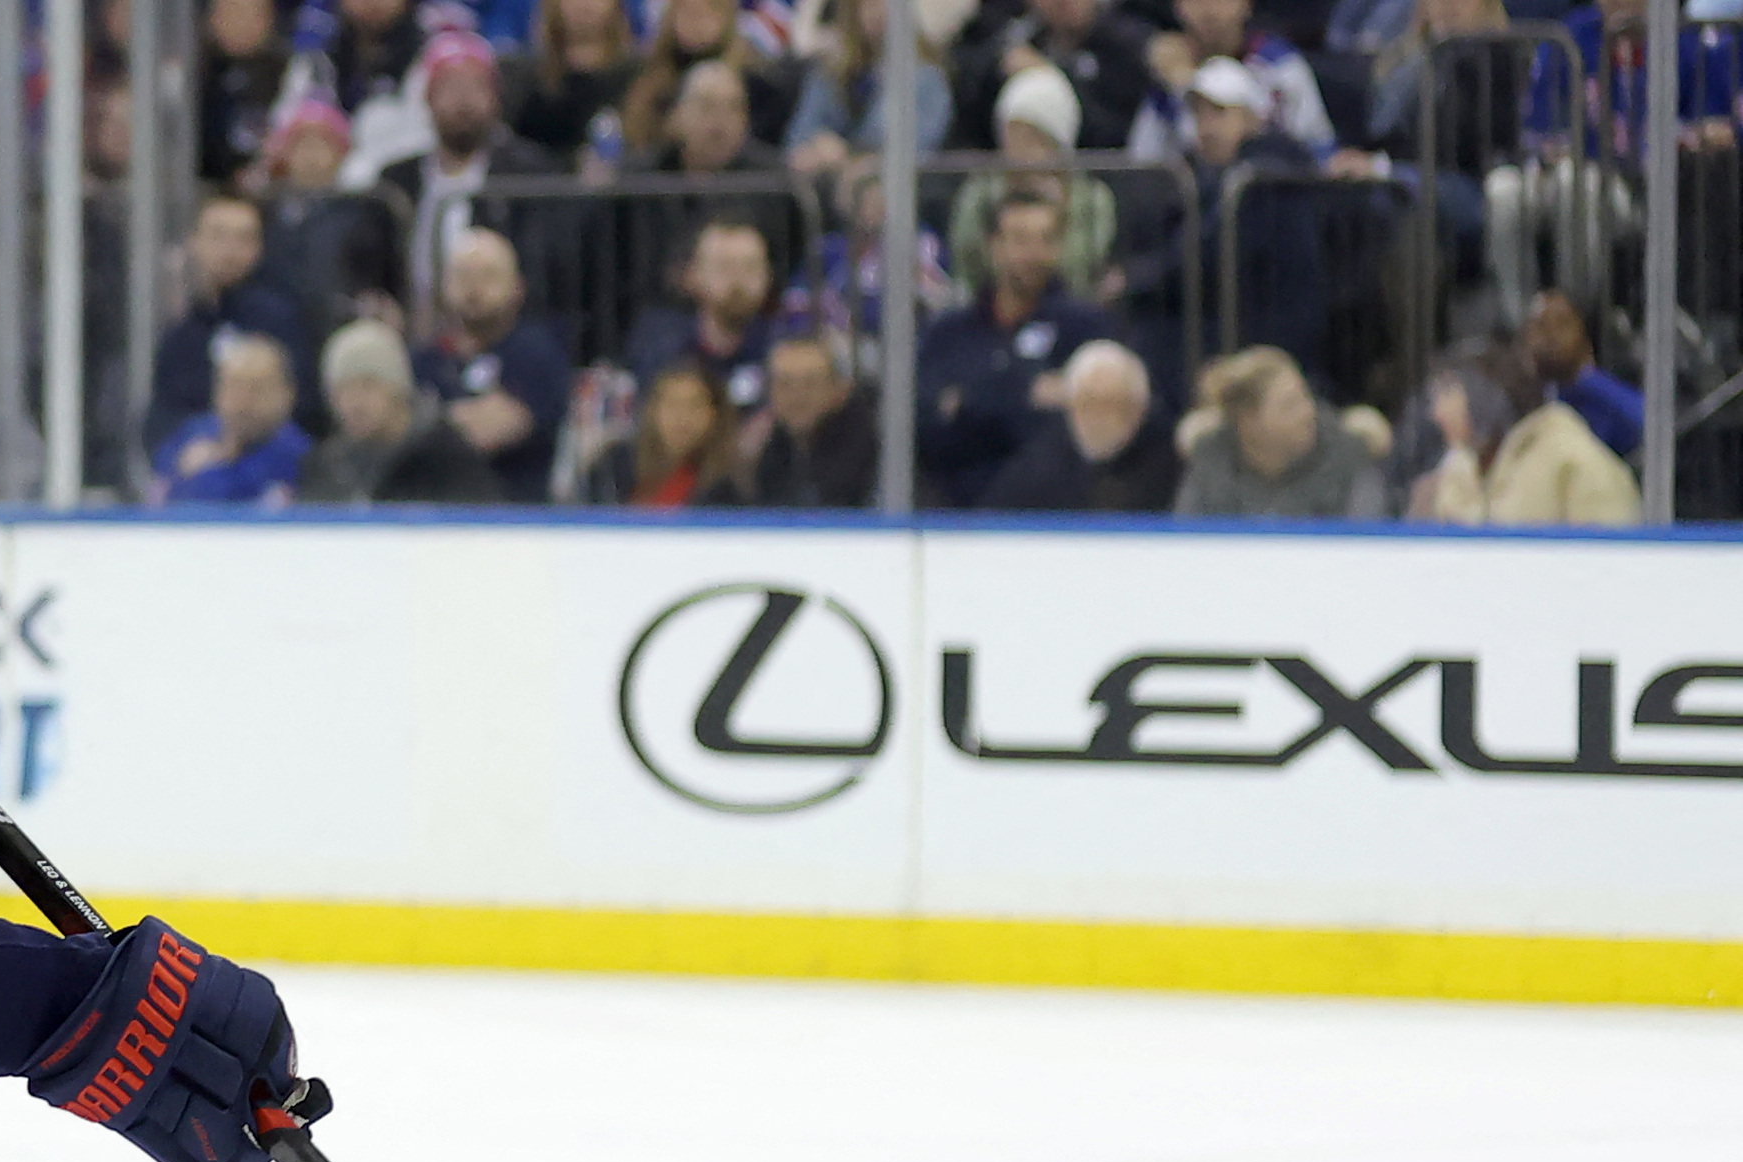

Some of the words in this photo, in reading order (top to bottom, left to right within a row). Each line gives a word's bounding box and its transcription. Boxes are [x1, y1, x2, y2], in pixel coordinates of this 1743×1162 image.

[37, 860, 59, 879] LEO
[55, 880, 68, 889] &
[64, 890, 107, 930] LENNON
